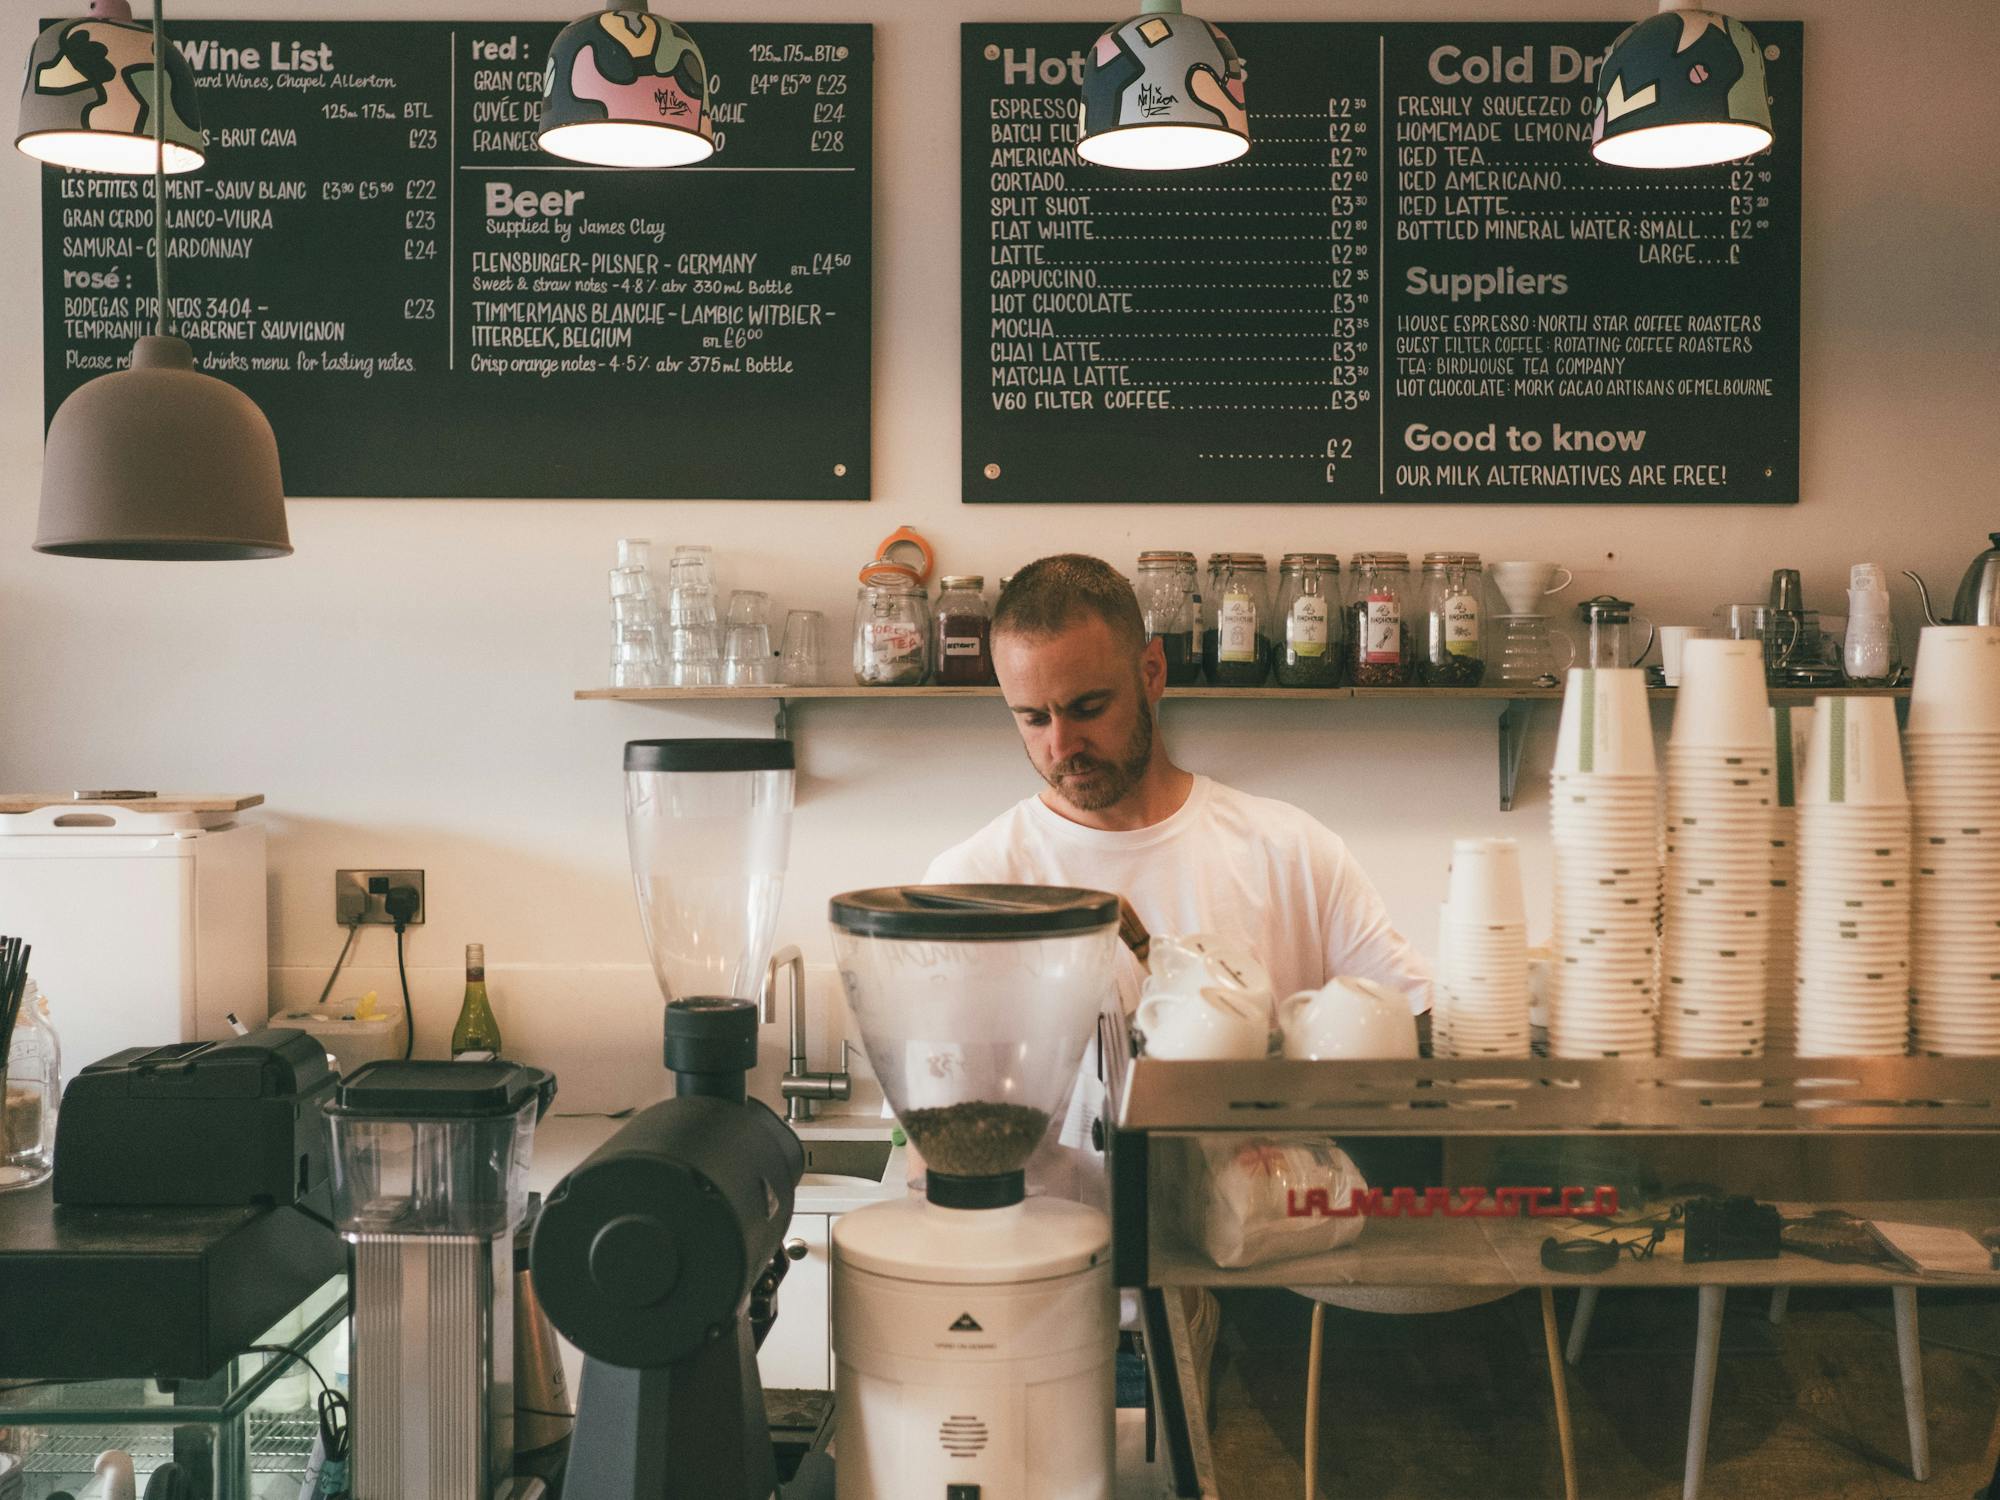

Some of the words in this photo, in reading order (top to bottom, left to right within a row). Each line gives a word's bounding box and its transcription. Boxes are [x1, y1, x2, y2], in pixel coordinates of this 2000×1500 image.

[173, 41, 260, 70] Wine
[271, 41, 334, 71] List
[1428, 46, 1533, 84] Cold
[1550, 46, 1603, 83] Dr
[1004, 48, 1085, 85] Hot
[226, 73, 273, 90] Wines,
[277, 74, 326, 93] Chapel
[330, 74, 396, 88] Allerton
[474, 70, 512, 90] GRAN
[817, 75, 846, 95] £23
[404, 102, 432, 118] BTL
[474, 96, 519, 122] CUVÉE
[814, 103, 845, 123] £24
[991, 98, 1078, 119] ESPRESSO
[1399, 96, 1472, 116] FRESHLY
[1483, 96, 1571, 116] SQUEEZED
[261, 129, 296, 146] CAVA
[410, 129, 437, 149] £23
[811, 131, 843, 151] £28
[992, 124, 1041, 143] BATCH
[1397, 122, 1501, 141] HOMEMADE
[1399, 147, 1436, 166] ICED
[1444, 147, 1484, 166] TEA
[62, 179, 84, 198] LES
[88, 179, 138, 198] PETITES
[259, 181, 306, 199] BLANC
[406, 180, 436, 199] £22
[991, 172, 1064, 191] CORTADO
[1399, 171, 1436, 191] ICED
[1445, 171, 1561, 190] AMERICANO
[486, 182, 584, 216] Beer
[991, 197, 1038, 216] SPLIT
[1046, 197, 1090, 215] SHOT
[1400, 196, 1436, 216] ICED
[1446, 196, 1509, 215] LATTE
[63, 208, 104, 227] GRAN
[109, 209, 153, 228] CERDO
[406, 210, 435, 230] £23
[486, 219, 549, 238] Supplied
[555, 218, 571, 243] by
[579, 219, 625, 235] James
[630, 218, 665, 243] Clay
[992, 221, 1031, 240] FLAT
[1038, 221, 1094, 240] WHITE
[1397, 220, 1478, 240] BOTTLED
[1486, 220, 1564, 239] MINERAL
[1640, 220, 1700, 239] SMALL
[64, 237, 132, 257] SAMURAI
[405, 239, 437, 260] £24
[991, 245, 1045, 265] LATTE
[1640, 244, 1695, 264] LARGE
[678, 253, 757, 275] GERMANY
[473, 276, 513, 291] Sweet
[517, 277, 528, 290] &
[533, 277, 571, 292] straw
[575, 278, 607, 293] notes
[661, 279, 687, 292] abv
[749, 280, 792, 294] Bottle
[991, 269, 1096, 289] CAPPUCCINO
[1406, 266, 1568, 302] Suppliers
[65, 297, 128, 317] BODEGAS
[136, 297, 201, 318] PIRNEOS
[206, 298, 251, 318] 3404
[405, 299, 435, 319] £23
[992, 294, 1026, 313] HOT
[1033, 293, 1132, 313] CHOCOLATE
[472, 302, 587, 323] TIMMERMANS
[682, 304, 743, 324] LAMBIC
[749, 304, 821, 325] WITBIER
[1398, 315, 1449, 332] HOUSE
[1593, 315, 1628, 331] STAR
[1634, 315, 1683, 331] COFFEE
[1688, 316, 1761, 332] ROASTERS
[182, 320, 256, 339] CABERNET
[261, 321, 344, 341] SAUVIGNON
[563, 327, 631, 348] BELGIUM
[991, 318, 1054, 338] MOCHA
[991, 343, 1032, 362] CHAI
[1043, 342, 1100, 361] LATTE
[1397, 337, 1439, 353] GUEST
[1445, 337, 1491, 353] FILTER
[1554, 337, 1621, 353] ROTATING
[1626, 337, 1674, 352] COFFEE
[1679, 336, 1752, 353] ROASTERS
[66, 350, 113, 369] Please
[203, 352, 248, 371] drinks
[251, 358, 290, 370] menu
[297, 351, 318, 370] for
[321, 352, 373, 378] tasting
[378, 353, 415, 371] notes.
[471, 354, 508, 376] Crisp
[511, 359, 558, 378] orange
[561, 355, 596, 371] notes
[656, 356, 683, 372] abv
[746, 356, 793, 373] Bottle
[1437, 357, 1514, 375] BIRDHOUSE
[1523, 358, 1549, 375] TEA
[1556, 357, 1625, 375] COMPANY
[992, 367, 1066, 386] MATCHA
[1074, 366, 1131, 386] LATTE
[1397, 379, 1425, 396] HOT
[1515, 379, 1554, 396] MORK
[1559, 380, 1603, 396] CACAO
[1607, 380, 1674, 395] ARTISANS
[992, 392, 1026, 410] V60
[1035, 391, 1093, 409] FILTER
[1105, 390, 1170, 409] COFFEE
[1405, 424, 1495, 451] Good
[1506, 426, 1542, 451] to
[1553, 423, 1646, 452] know
[1396, 465, 1431, 486] OUR
[1437, 465, 1480, 486] MILK
[1487, 465, 1621, 486] ALTERNATIVES
[1629, 465, 1666, 485] ARE
[1674, 465, 1726, 485] FREE!
